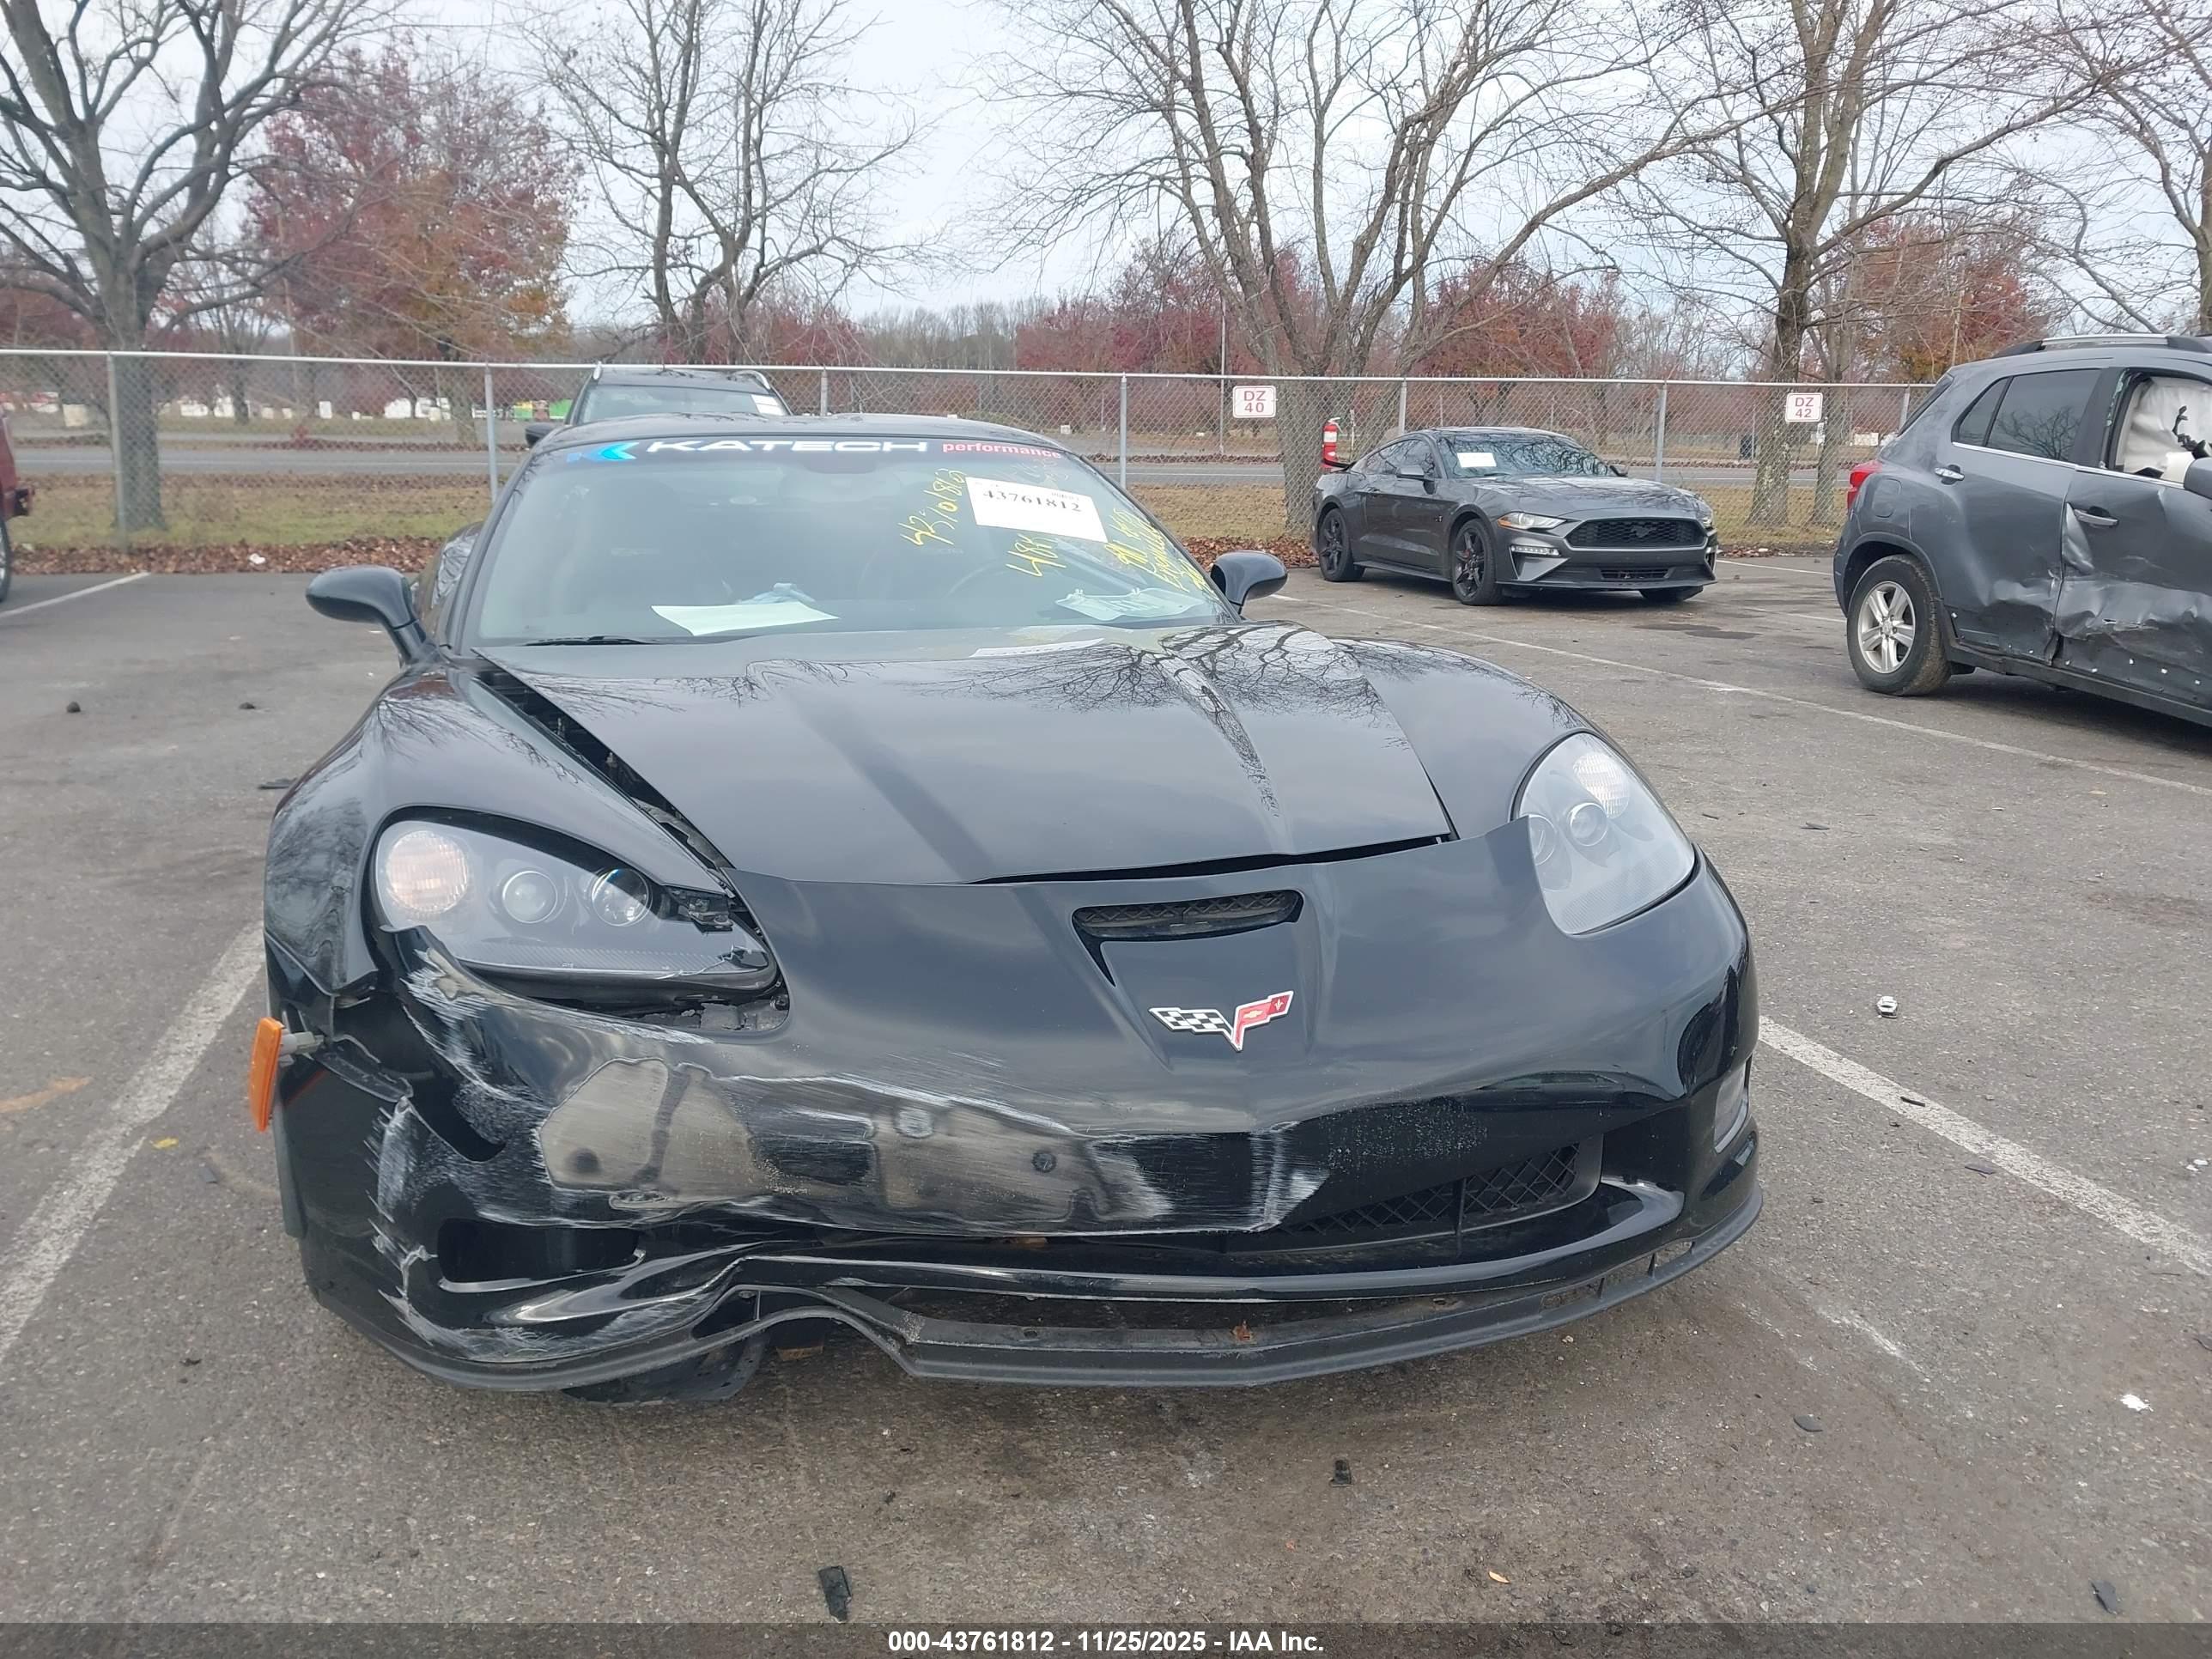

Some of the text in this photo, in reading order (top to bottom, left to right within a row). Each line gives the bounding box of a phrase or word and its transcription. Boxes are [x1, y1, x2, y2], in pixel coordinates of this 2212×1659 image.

[1243, 391, 1267, 401] DZ
[1795, 397, 1814, 407] DZ
[1244, 402, 1265, 413] 40
[1795, 408, 1813, 418] 42
[646, 440, 928, 453] KATECH
[942, 442, 1062, 459] performance
[982, 489, 1083, 513] 43761812
